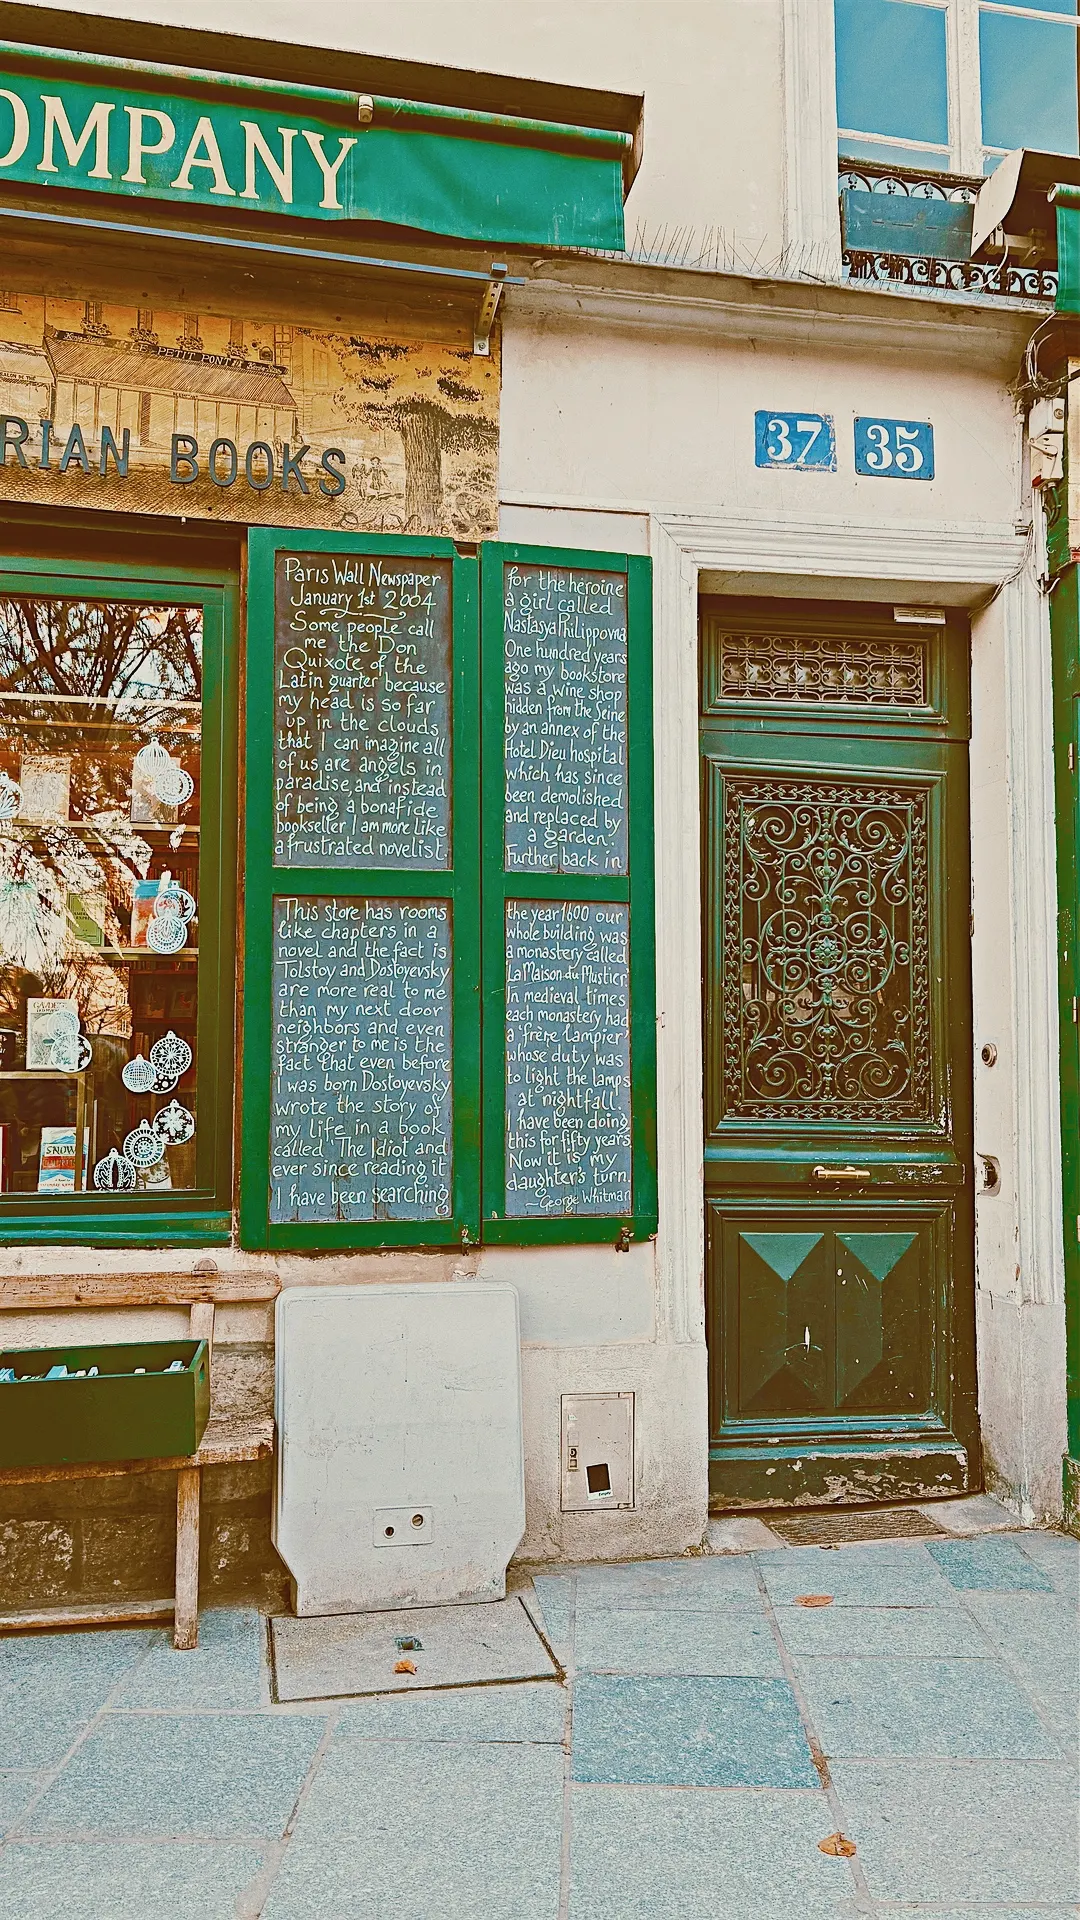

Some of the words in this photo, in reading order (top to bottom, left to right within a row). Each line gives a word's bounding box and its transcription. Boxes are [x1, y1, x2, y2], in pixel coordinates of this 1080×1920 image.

[157, 346, 195, 360] PETIT
[201, 353, 231, 366] PONT
[767, 419, 823, 464] 37
[866, 424, 924, 472] 35
[170, 433, 346, 496] BOOKS
[285, 557, 329, 584] Paris
[332, 560, 364, 585] Wall
[369, 561, 441, 595] Newspaper
[508, 567, 532, 589] for
[539, 571, 565, 592] the
[290, 584, 353, 616] January
[358, 588, 375, 608] 1st
[383, 591, 436, 615] 2004
[505, 593, 514, 606] a
[520, 593, 554, 616] girl
[558, 596, 612, 615] called
[290, 611, 340, 633] Some
[348, 618, 402, 640] people
[408, 618, 434, 638] call
[504, 609, 556, 641] Nastasya
[305, 638, 326, 648] me
[339, 634, 370, 652] the
[378, 635, 417, 655] Don
[505, 639, 532, 657] One
[536, 642, 590, 662] hundred
[594, 652, 627, 671] years
[284, 648, 363, 671] Quixote
[370, 655, 387, 676] of
[395, 656, 427, 674] the
[505, 662, 528, 681] ago
[535, 664, 554, 682] my
[561, 662, 626, 683] bookstore
[279, 670, 323, 689] Latin
[328, 672, 378, 694] quarter
[385, 672, 446, 693] because
[505, 683, 531, 694] was
[537, 683, 546, 695] a
[553, 683, 585, 698] wine
[589, 685, 621, 709] shop
[286, 717, 306, 734] up
[316, 714, 332, 730] in
[340, 712, 369, 731] the
[378, 715, 439, 736] clouds
[505, 739, 536, 759] Hotel
[539, 740, 566, 760] Dieu
[570, 739, 624, 768] hospital
[276, 770, 353, 800] paradise,
[355, 780, 380, 793] and
[388, 778, 447, 797] instead
[506, 761, 550, 782] which
[555, 763, 578, 784] has
[585, 769, 622, 785] since
[505, 784, 535, 802] been
[541, 786, 623, 809] demolished
[505, 807, 529, 823] and
[534, 806, 598, 829] replaced
[605, 811, 621, 836] by
[275, 841, 283, 855] a
[287, 834, 374, 859] frustrated
[380, 837, 447, 860] novelist.
[528, 828, 536, 842] a
[544, 828, 614, 848] garden.
[506, 844, 557, 866] Further
[562, 847, 598, 866] back
[605, 851, 621, 868] in
[279, 898, 318, 921] This
[325, 899, 360, 921] store
[366, 901, 392, 920] has
[400, 907, 447, 920] rooms
[506, 902, 528, 919] the
[531, 909, 559, 925] year
[561, 902, 589, 922] 1600
[596, 913, 623, 924] our
[278, 921, 316, 939] like
[322, 923, 396, 945] chapters
[404, 923, 416, 938] in
[427, 926, 437, 938] a
[506, 922, 541, 941] whole
[544, 924, 597, 951] building
[600, 932, 627, 945] was
[506, 945, 513, 959] a
[517, 942, 583, 969] monastery
[586, 946, 627, 965] called
[276, 959, 336, 985] Tolstoy
[340, 958, 365, 977] and
[365, 959, 450, 987] Dostoyevsky
[523, 962, 562, 982] Maison
[565, 966, 579, 980] du
[507, 986, 519, 1004] In
[524, 986, 579, 1004] medieval
[586, 986, 625, 1007] times
[280, 1000, 316, 1017] than
[327, 1005, 348, 1021] my
[356, 1000, 391, 1016] next
[399, 1002, 443, 1017] door
[506, 1005, 533, 1021] each
[538, 1006, 601, 1031] monastery
[606, 1007, 628, 1026] had
[277, 1019, 359, 1043] neighbors
[368, 1019, 398, 1035] and
[406, 1024, 444, 1037] even
[506, 1028, 514, 1042] a
[278, 1055, 313, 1075] fact
[360, 1057, 395, 1069] even
[402, 1054, 451, 1075] before
[507, 1044, 547, 1063] whose
[552, 1044, 590, 1072] duty
[596, 1054, 623, 1067] was
[277, 1076, 280, 1093] I
[288, 1080, 316, 1092] was
[324, 1073, 357, 1092] born
[362, 1070, 451, 1101] Dostoyevsky
[275, 1097, 327, 1116] wrote
[337, 1095, 365, 1113] the
[372, 1095, 416, 1120] story
[425, 1094, 441, 1117] of
[517, 1089, 535, 1107] at
[543, 1088, 621, 1117] nightfall.
[46, 1145, 75, 1155] SNOW
[274, 1140, 323, 1157] called
[415, 1138, 447, 1155] and
[508, 1132, 536, 1149] this
[540, 1130, 559, 1154] for
[561, 1130, 590, 1155] fifty
[272, 1162, 307, 1177] ever
[312, 1160, 359, 1176] since
[364, 1160, 427, 1184] reading
[432, 1158, 447, 1176] it
[506, 1167, 586, 1197] daughter's
[593, 1167, 631, 1186] turn.
[582, 1187, 631, 1204] Whitman
